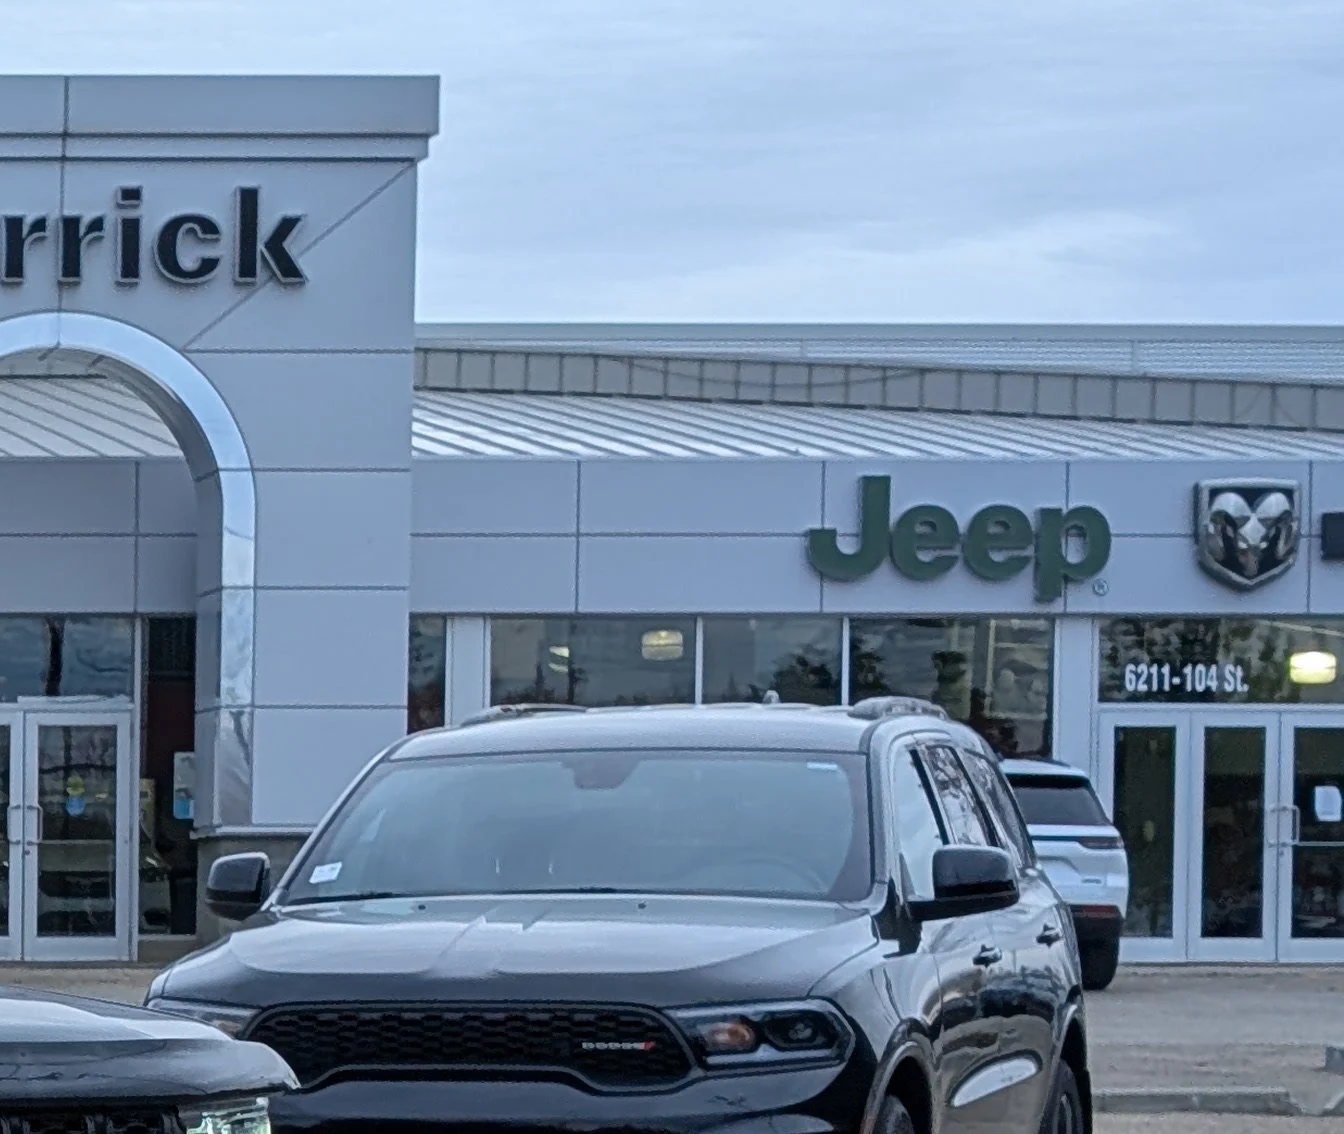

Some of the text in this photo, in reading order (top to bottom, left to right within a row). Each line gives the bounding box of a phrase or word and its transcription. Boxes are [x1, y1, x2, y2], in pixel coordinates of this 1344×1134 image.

[806, 475, 1112, 603] Jeep
[1125, 663, 1249, 692] 6211-104 St.
